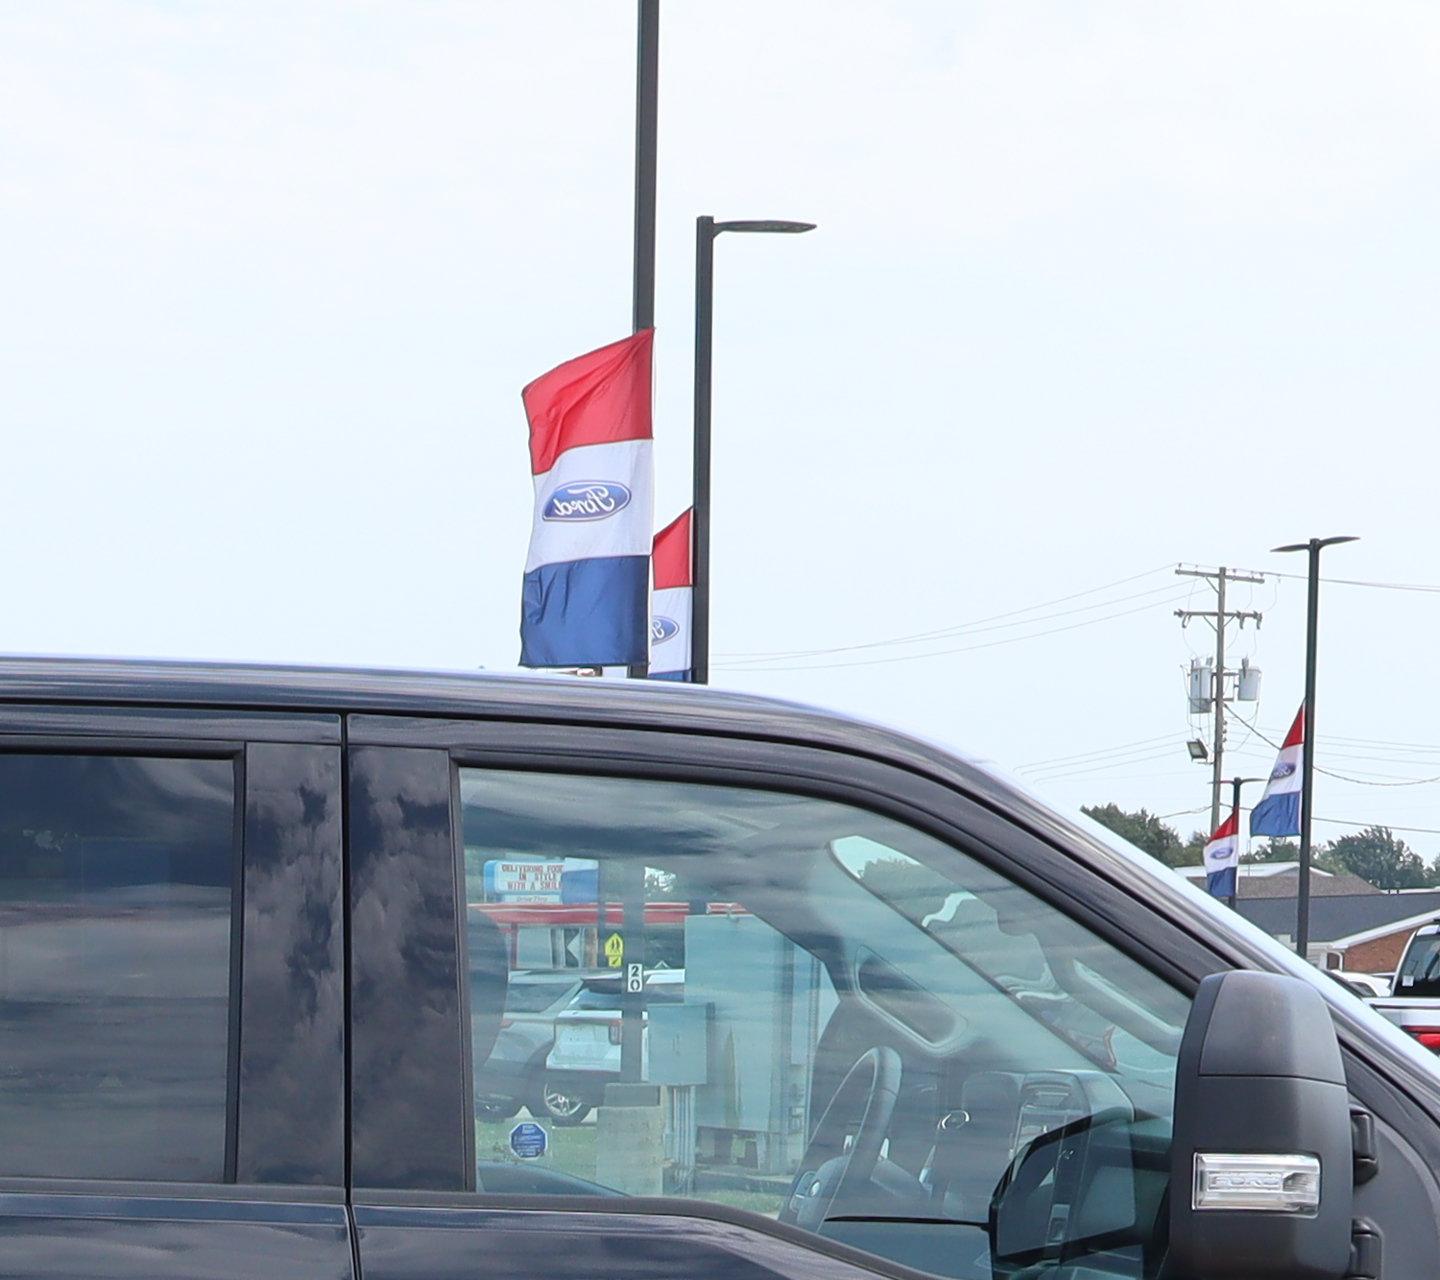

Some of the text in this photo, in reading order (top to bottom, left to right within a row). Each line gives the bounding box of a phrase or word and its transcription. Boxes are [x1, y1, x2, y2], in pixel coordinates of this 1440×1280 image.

[518, 872, 527, 881] IN
[507, 881, 526, 891] WITH
[530, 881, 536, 891] A
